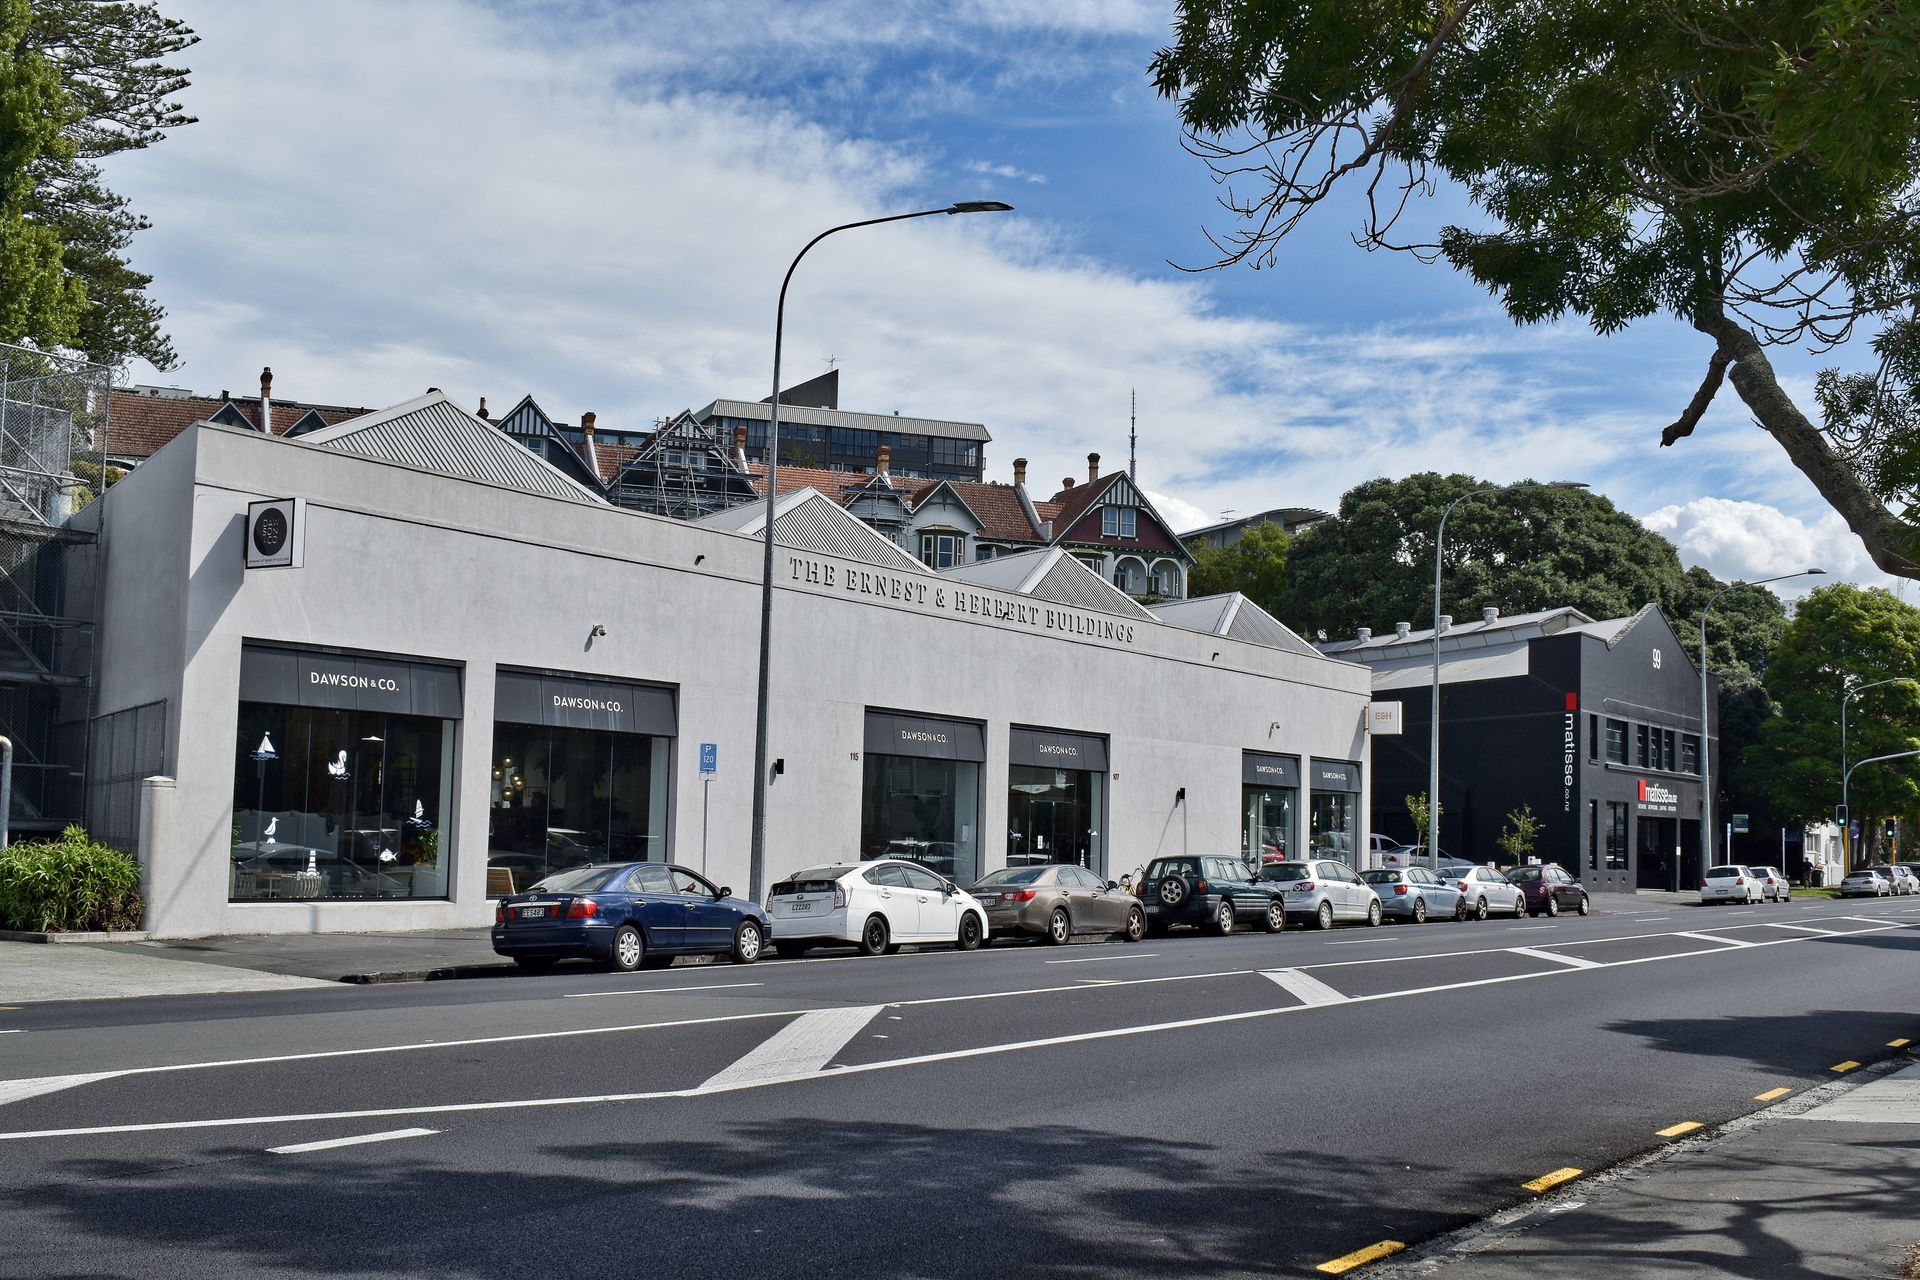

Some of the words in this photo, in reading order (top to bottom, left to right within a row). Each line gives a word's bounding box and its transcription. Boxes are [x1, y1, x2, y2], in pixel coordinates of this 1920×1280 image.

[262, 527, 279, 537] SON
[789, 556, 835, 587] THE
[846, 568, 927, 604] ERNEST
[935, 587, 945, 608] &
[954, 590, 1039, 625] HERBERT
[1046, 609, 1134, 643] BUILDINGS
[1652, 648, 1661, 670] 99
[1375, 711, 1392, 720] E&H
[705, 745, 712, 753] P
[703, 755, 714, 763] 120
[850, 752, 859, 761] 115
